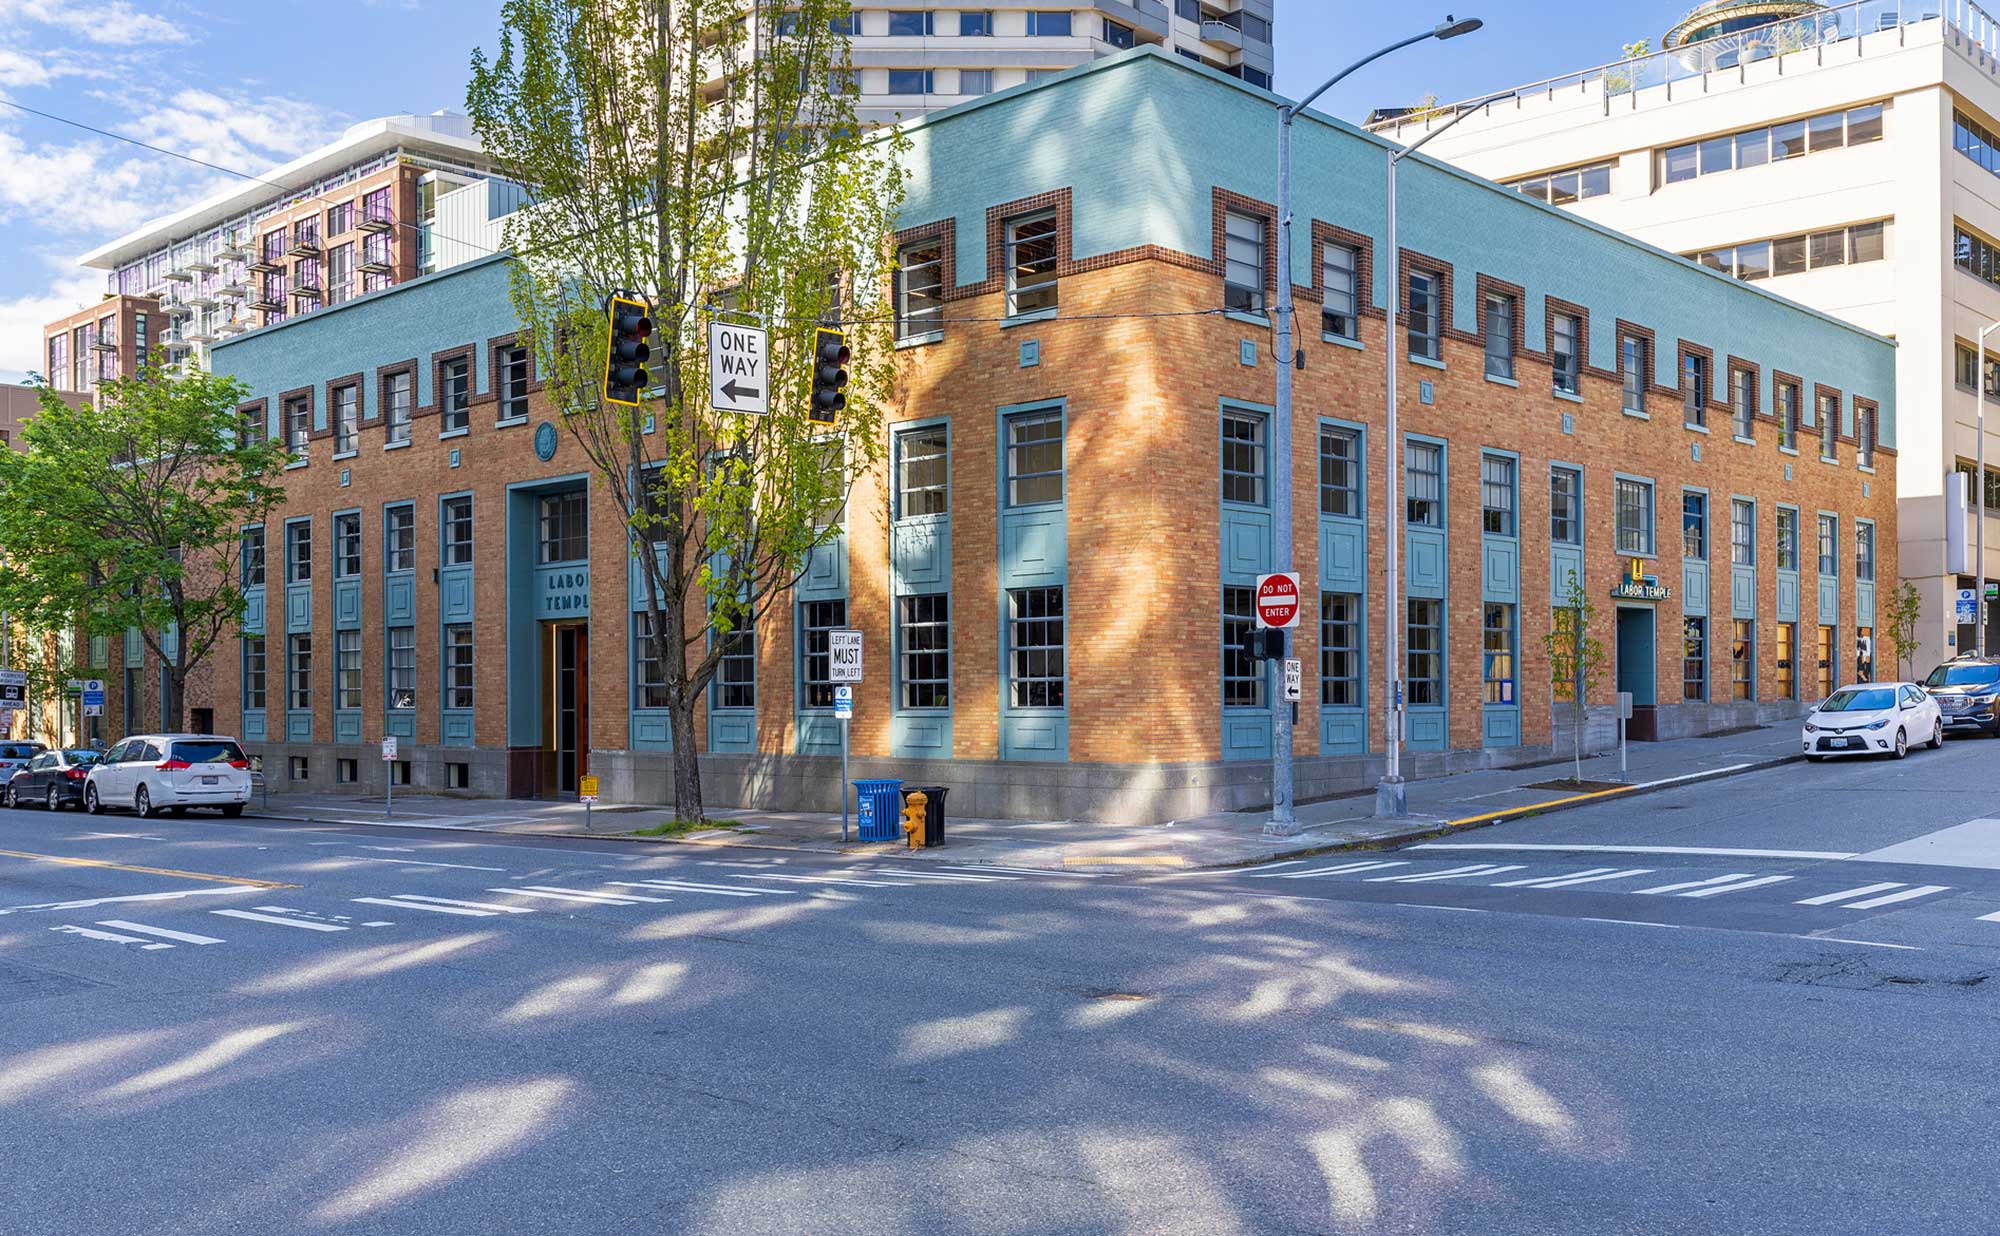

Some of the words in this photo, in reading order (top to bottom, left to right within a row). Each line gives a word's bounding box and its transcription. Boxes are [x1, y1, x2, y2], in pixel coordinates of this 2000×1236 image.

[720, 331, 757, 354] ONE
[720, 354, 758, 377] WAY
[1263, 585, 1274, 594] DO
[1277, 583, 1293, 593] NOT
[1619, 583, 1643, 597] LABOR
[1645, 586, 1671, 599] TEMPLE
[1265, 607, 1290, 617] ENTER
[832, 635, 845, 645] LEFT
[847, 635, 861, 645] LANE
[833, 648, 860, 664] MUST
[832, 667, 846, 677] TURN
[846, 667, 861, 678] LEFT
[1286, 661, 1300, 673] ONE
[1286, 673, 1300, 684] WAY
